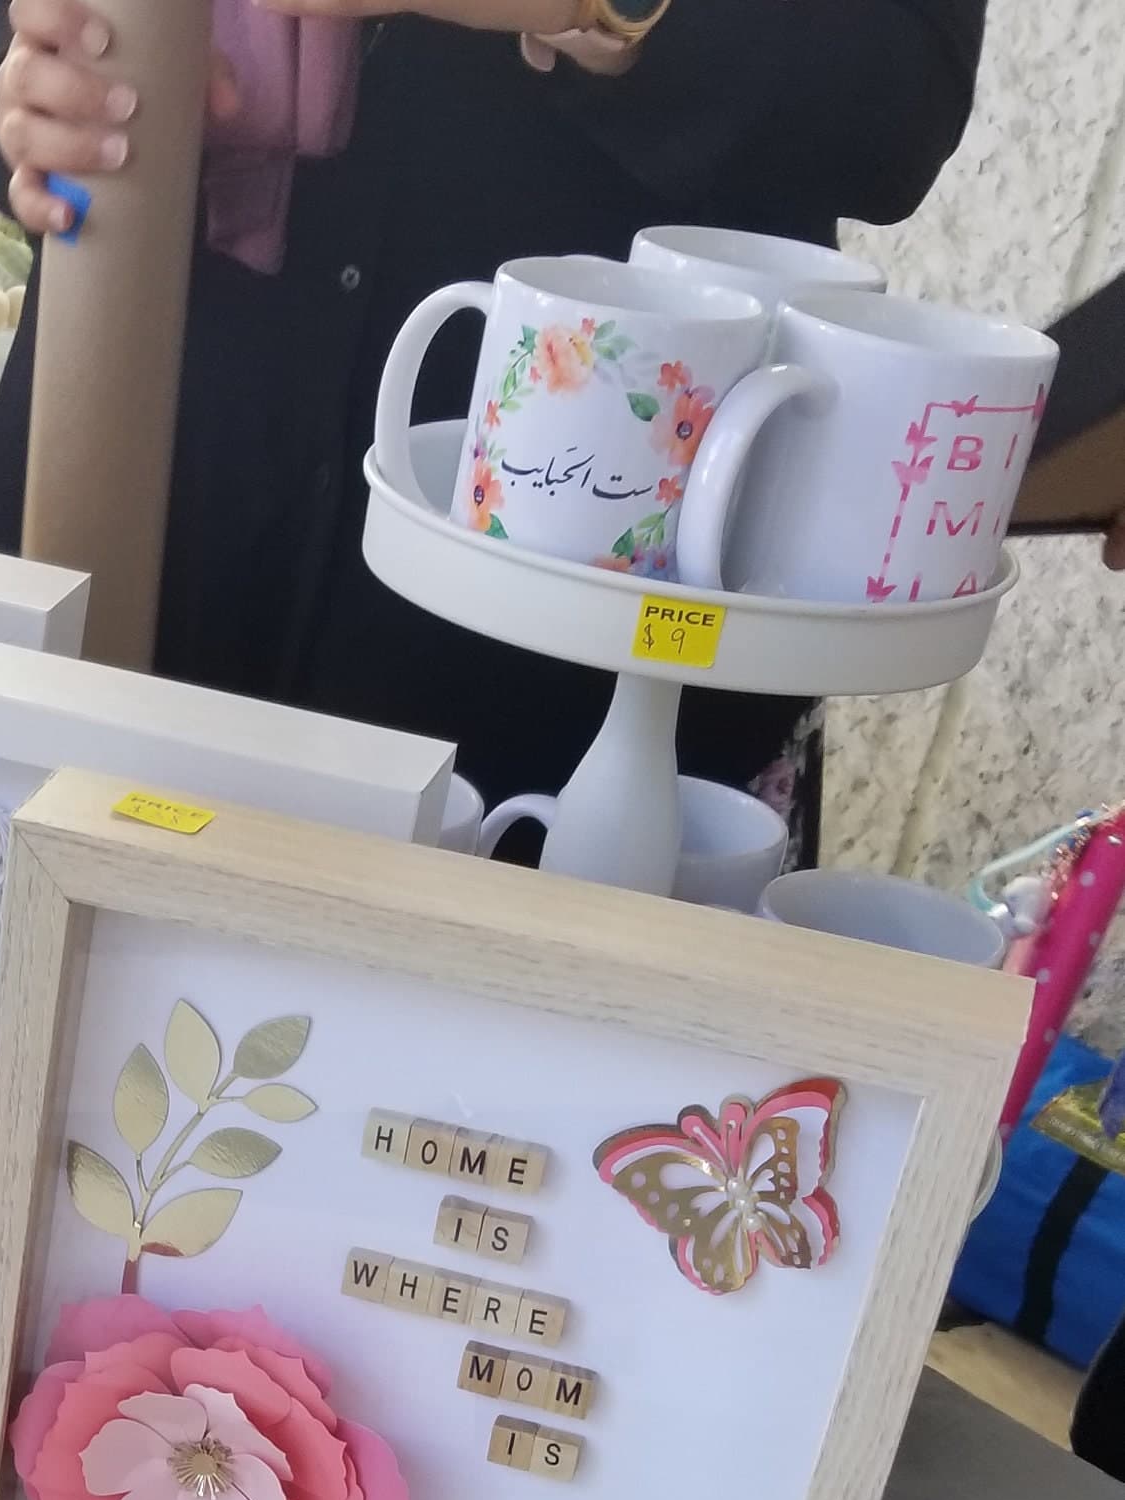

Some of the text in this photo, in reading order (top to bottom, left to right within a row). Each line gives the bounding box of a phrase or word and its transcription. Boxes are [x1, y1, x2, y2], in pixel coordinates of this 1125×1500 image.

[591, 474, 654, 500] ست
[644, 605, 716, 627] PRICE
[374, 1125, 529, 1186] HOME
[453, 1216, 510, 1255] IS
[351, 1259, 549, 1336] WHERE
[467, 1354, 582, 1408] MOM
[505, 1431, 561, 1469] IS
